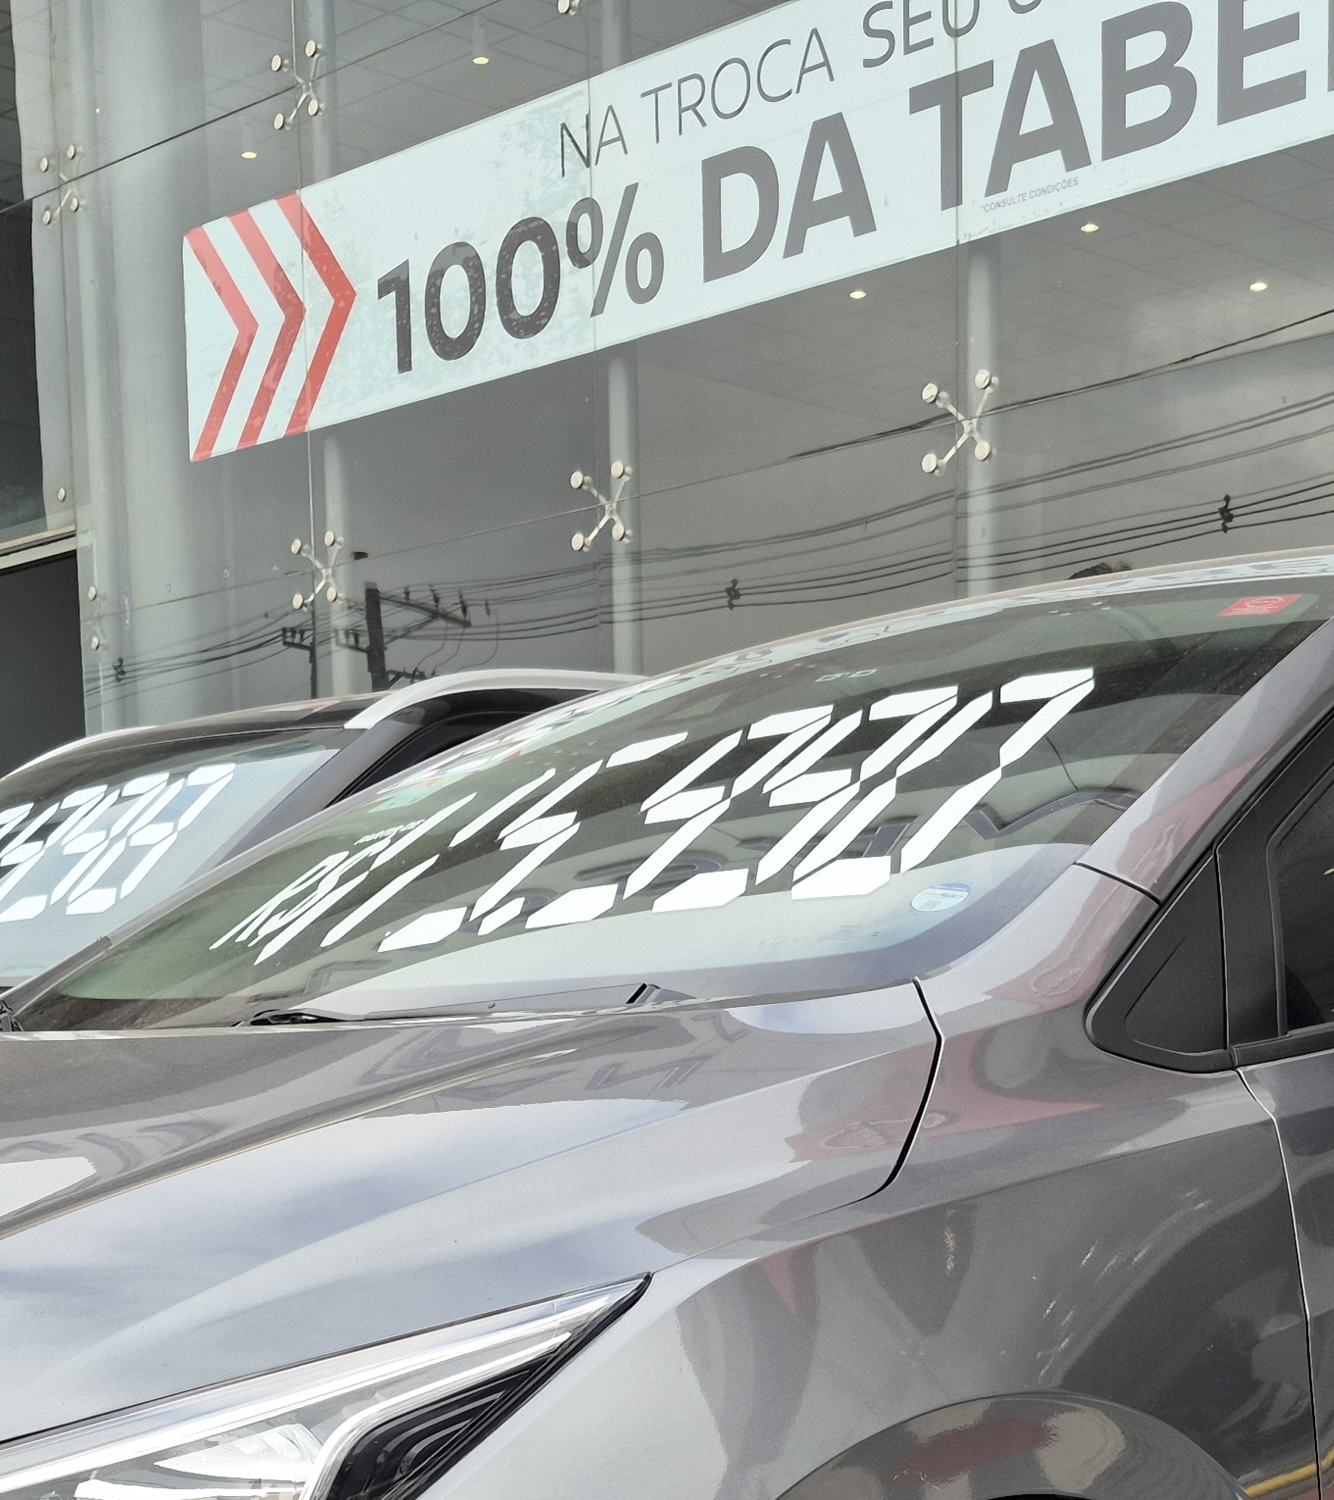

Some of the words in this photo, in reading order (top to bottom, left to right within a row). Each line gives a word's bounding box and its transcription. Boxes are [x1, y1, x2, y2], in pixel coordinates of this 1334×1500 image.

[557, 112, 631, 178] NA
[639, 27, 837, 146] TROCA
[862, 0, 981, 68] SEU
[376, 182, 666, 375] 100%
[702, 112, 878, 285] DA
[1028, 176, 1079, 200] CONDIÇÕES
